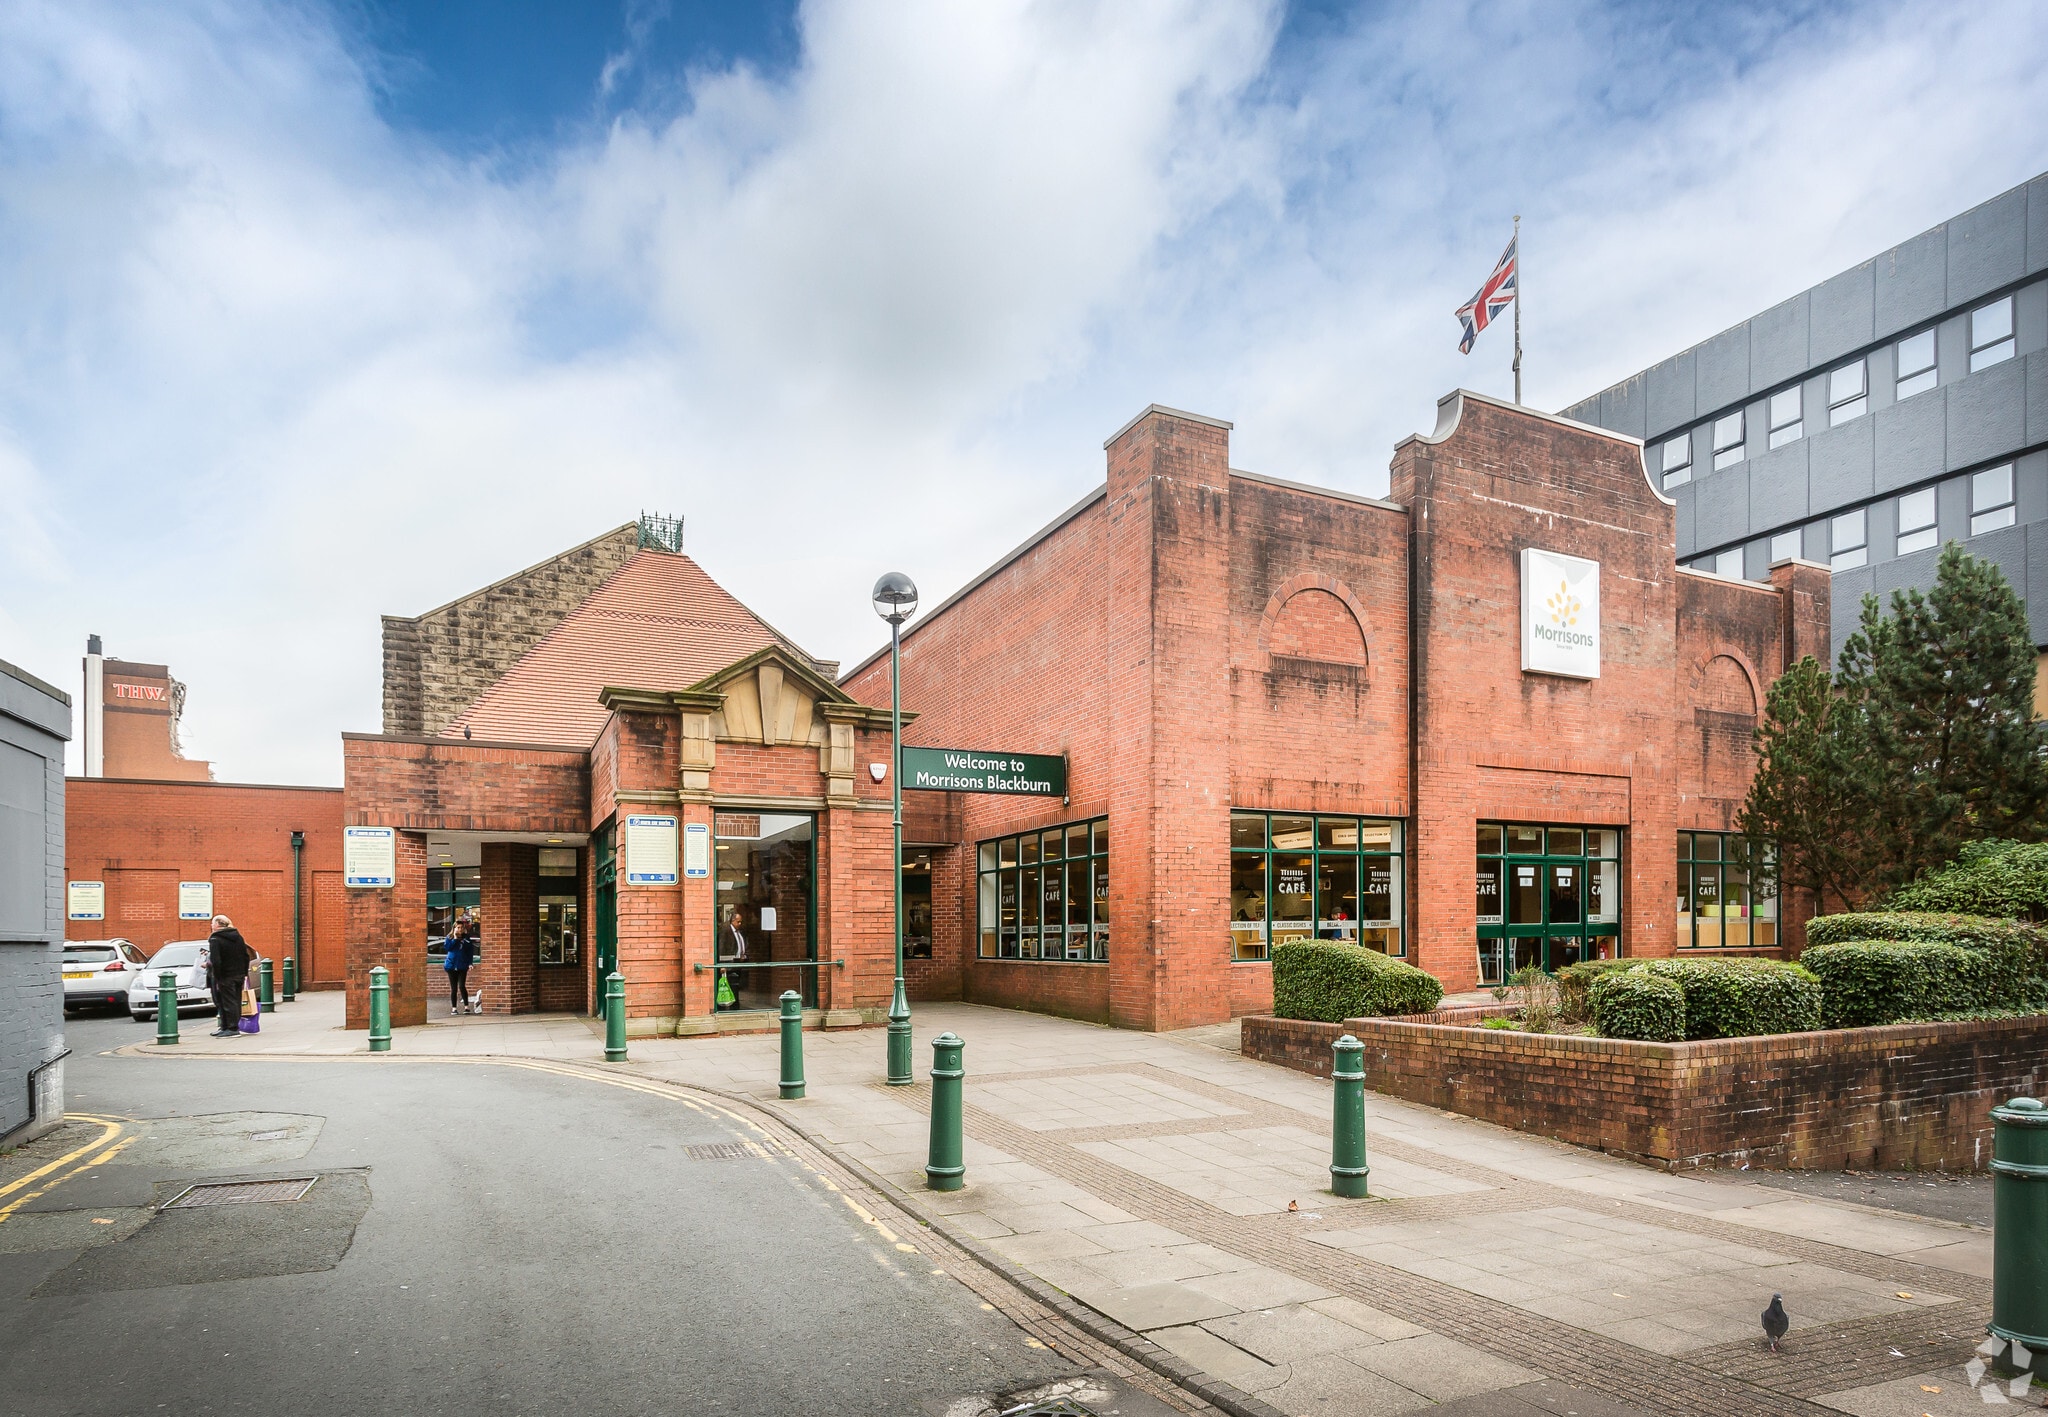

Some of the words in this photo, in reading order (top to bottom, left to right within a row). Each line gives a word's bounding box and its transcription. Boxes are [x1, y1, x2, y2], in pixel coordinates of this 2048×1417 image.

[1534, 621, 1594, 647] Morrisons
[112, 683, 166, 701] THW
[944, 753, 1007, 771] Welcome
[1010, 758, 1025, 772] to
[916, 771, 984, 789] Morrisons
[987, 775, 1051, 792] Blackburn
[1096, 886, 1109, 898] CAF
[1279, 881, 1306, 894] CAFÉ
[1369, 883, 1391, 894] CAF
[1591, 885, 1601, 895] CA
[1699, 886, 1717, 896] CAFÉ
[1002, 893, 1015, 905] CAFÉ
[1045, 889, 1060, 901] CAFÉ
